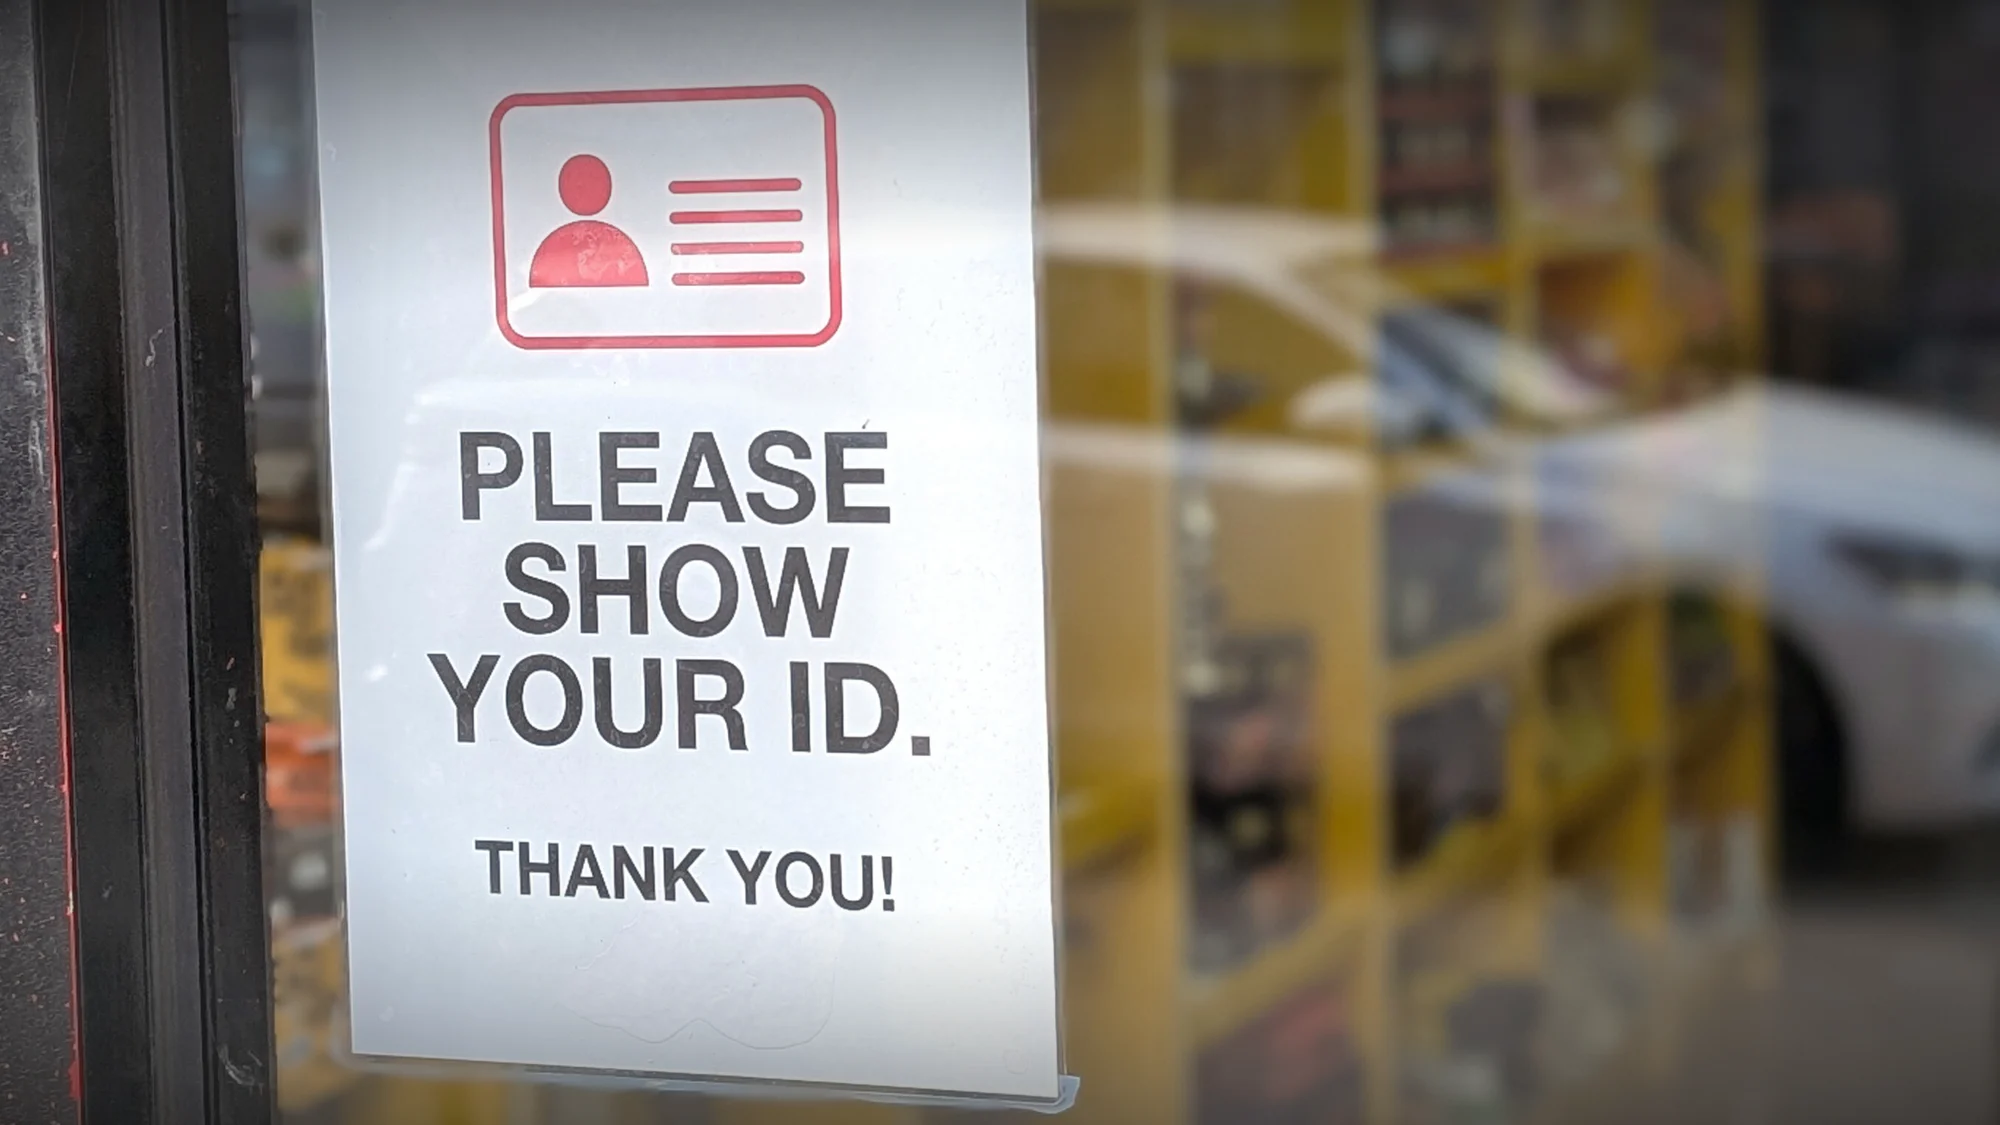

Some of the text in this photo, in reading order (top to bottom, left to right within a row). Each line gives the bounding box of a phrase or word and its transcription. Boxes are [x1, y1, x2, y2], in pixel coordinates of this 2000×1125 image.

[459, 430, 891, 525] PLEASE
[503, 542, 850, 638] SHOW
[427, 653, 931, 757] YOUR ID.
[475, 840, 895, 912] THANK YOU!
